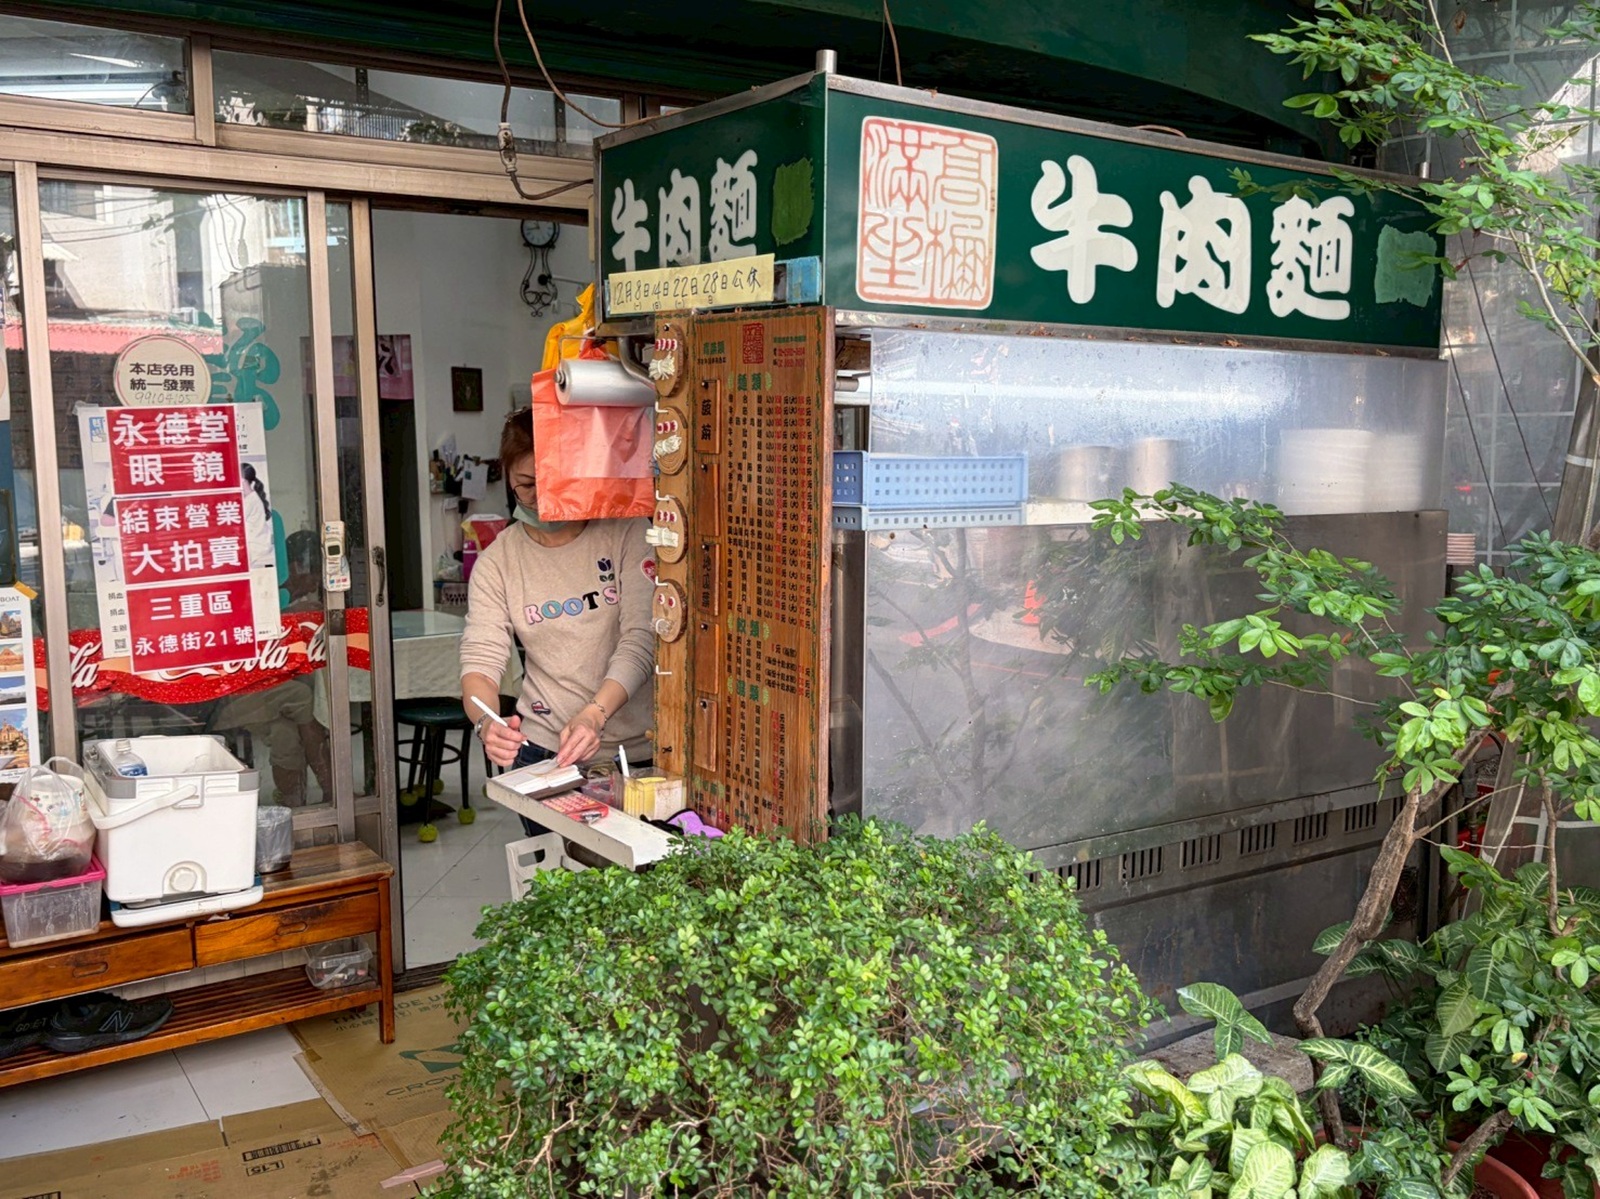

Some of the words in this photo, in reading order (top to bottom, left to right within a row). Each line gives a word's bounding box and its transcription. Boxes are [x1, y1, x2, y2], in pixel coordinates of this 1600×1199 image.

[611, 149, 759, 272] 牛肉麵
[1030, 154, 1355, 320] 牛肉麵
[129, 362, 195, 377] 本店免用
[129, 378, 195, 393] 統一發票
[113, 410, 230, 447] 永德堂
[121, 501, 242, 535] 結束營業
[130, 536, 242, 576] 大拍賣
[150, 590, 233, 621] 三重區
[524, 586, 621, 625] ROOTS
[135, 625, 254, 656] 永德街21號
